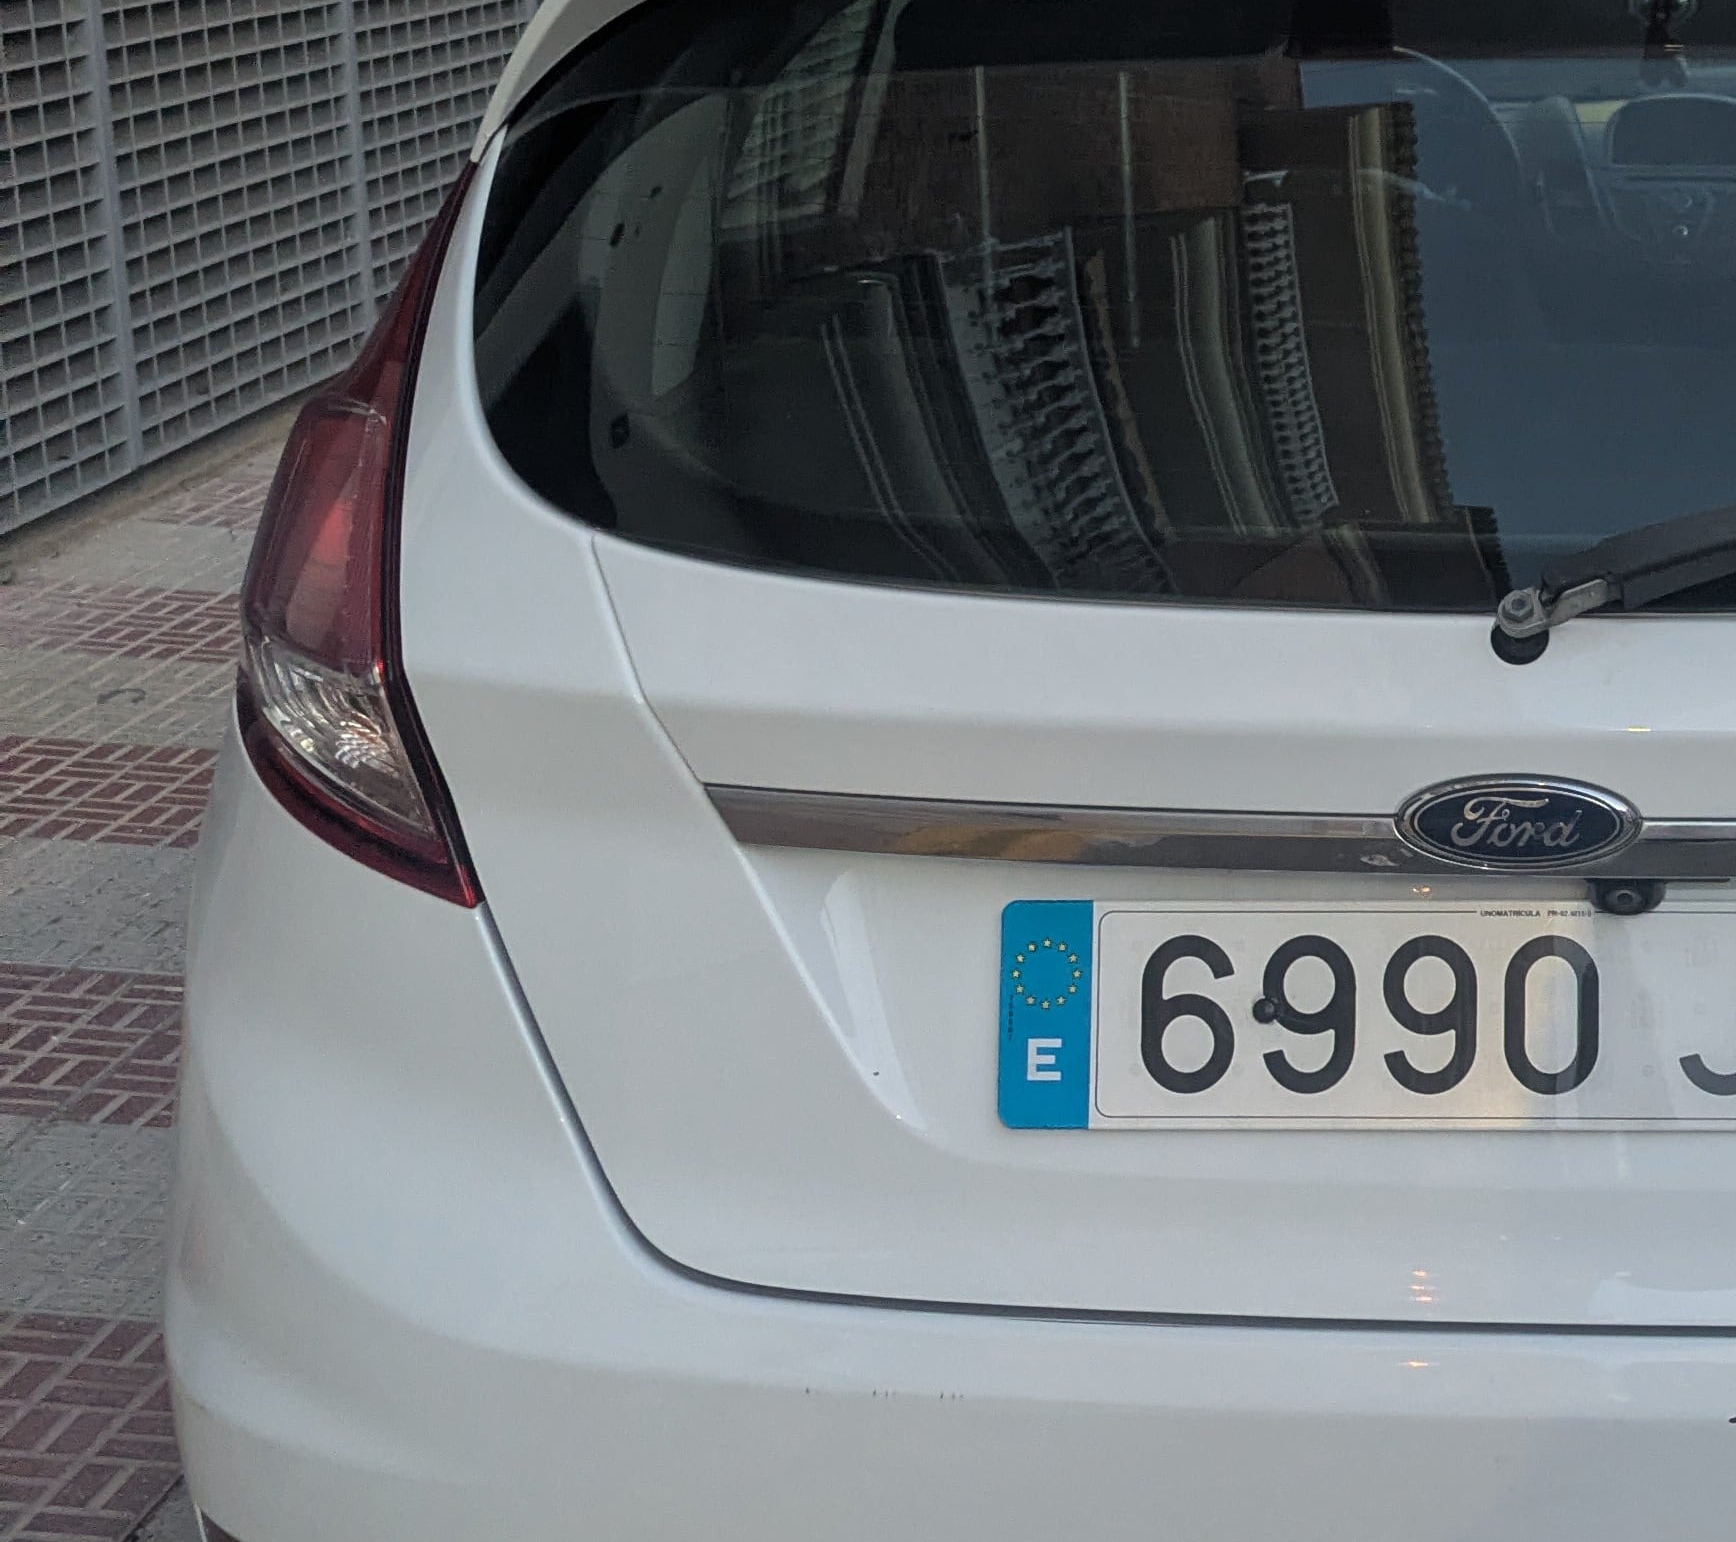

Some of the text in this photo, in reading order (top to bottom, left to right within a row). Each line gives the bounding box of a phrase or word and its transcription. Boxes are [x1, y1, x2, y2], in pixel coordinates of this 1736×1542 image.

[1450, 796, 1583, 848] Ford
[1140, 934, 1600, 1095] 6990
[1026, 1037, 1063, 1082] E
